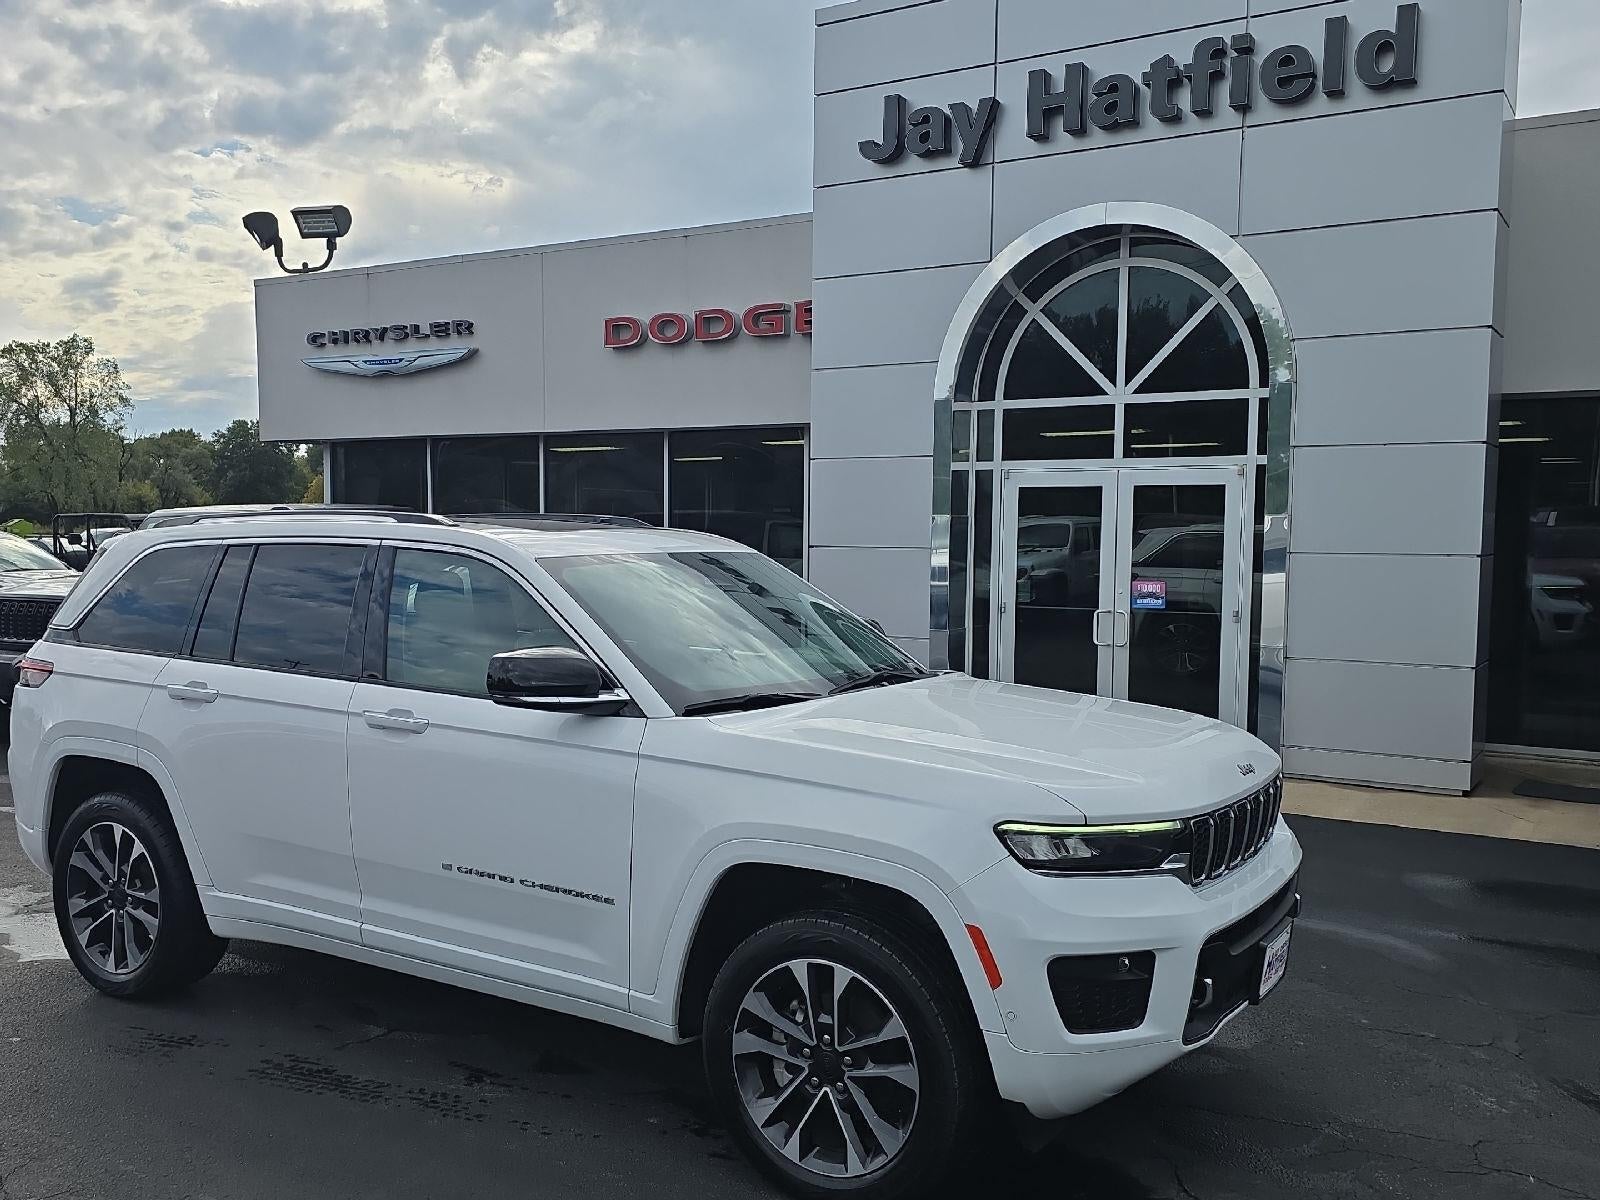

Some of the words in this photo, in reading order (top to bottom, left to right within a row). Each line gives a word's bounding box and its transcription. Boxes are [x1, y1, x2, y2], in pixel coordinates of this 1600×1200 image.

[858, 94, 1000, 167] Jay
[1027, 3, 1420, 141] Hatfield
[307, 319, 475, 347] CHRYSLER
[1236, 763, 1256, 776] Jeep
[519, 879, 616, 905] CHEROKEE
